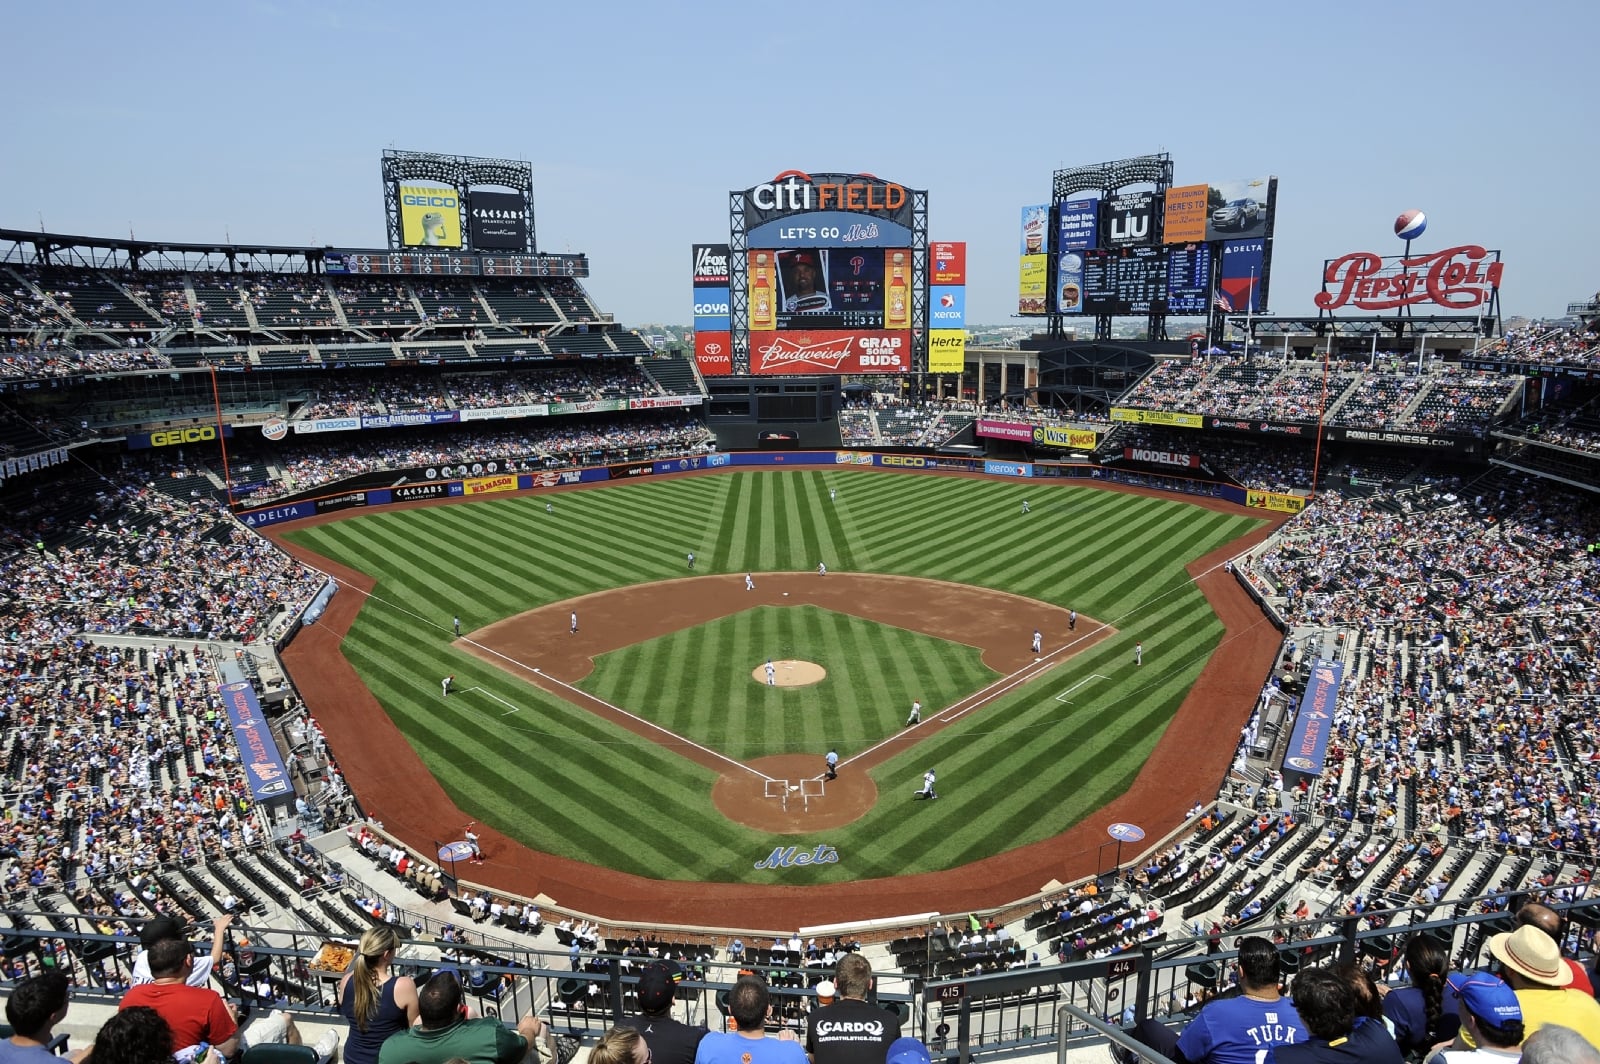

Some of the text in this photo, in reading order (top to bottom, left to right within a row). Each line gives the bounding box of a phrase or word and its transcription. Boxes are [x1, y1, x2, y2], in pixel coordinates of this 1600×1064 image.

[753, 177, 906, 210] citi FIELD
[1181, 190, 1205, 198] EQUINOX
[403, 195, 456, 208] GEICO
[1167, 200, 1205, 211] HERE'S TO
[472, 209, 524, 219] CAESARS
[1061, 214, 1081, 223] Watch
[1061, 222, 1080, 230] Listen
[1111, 213, 1149, 239] LIU
[780, 222, 879, 242] LET'S GO Mets
[704, 255, 727, 266] FOX
[699, 265, 728, 276] NEWS
[694, 303, 729, 314] GOYA
[860, 317, 866, 325] 3
[869, 317, 875, 325] 2
[877, 316, 882, 325] 1
[934, 311, 961, 319] xerox
[859, 337, 902, 349] GRAB
[931, 337, 962, 347] Hertz
[758, 345, 851, 362] Budweiser
[859, 355, 901, 366] BUDS
[575, 402, 596, 413] Veggie
[630, 400, 656, 408] BOB'S
[389, 414, 432, 424] Authority
[264, 424, 285, 435] Gulf
[316, 421, 357, 430] mazda
[1220, 421, 1235, 429] pepsi
[1268, 425, 1285, 433] pepsi
[151, 427, 216, 447] GEICO
[1047, 430, 1095, 445] WISE SNACKS
[712, 457, 724, 466] citi
[881, 456, 925, 467] GEICO
[1132, 449, 1191, 467] MODELL'S
[629, 467, 652, 475] verizon
[988, 464, 1015, 474] xerox
[396, 486, 442, 496] CAESARS
[259, 507, 298, 522] DELTA
[250, 763, 282, 781] Mets
[754, 844, 839, 869] Mets
[1113, 963, 1129, 972] 414
[942, 986, 959, 998] 415
[823, 1021, 876, 1032] CARDO
[1247, 1024, 1297, 1046] TUCK
